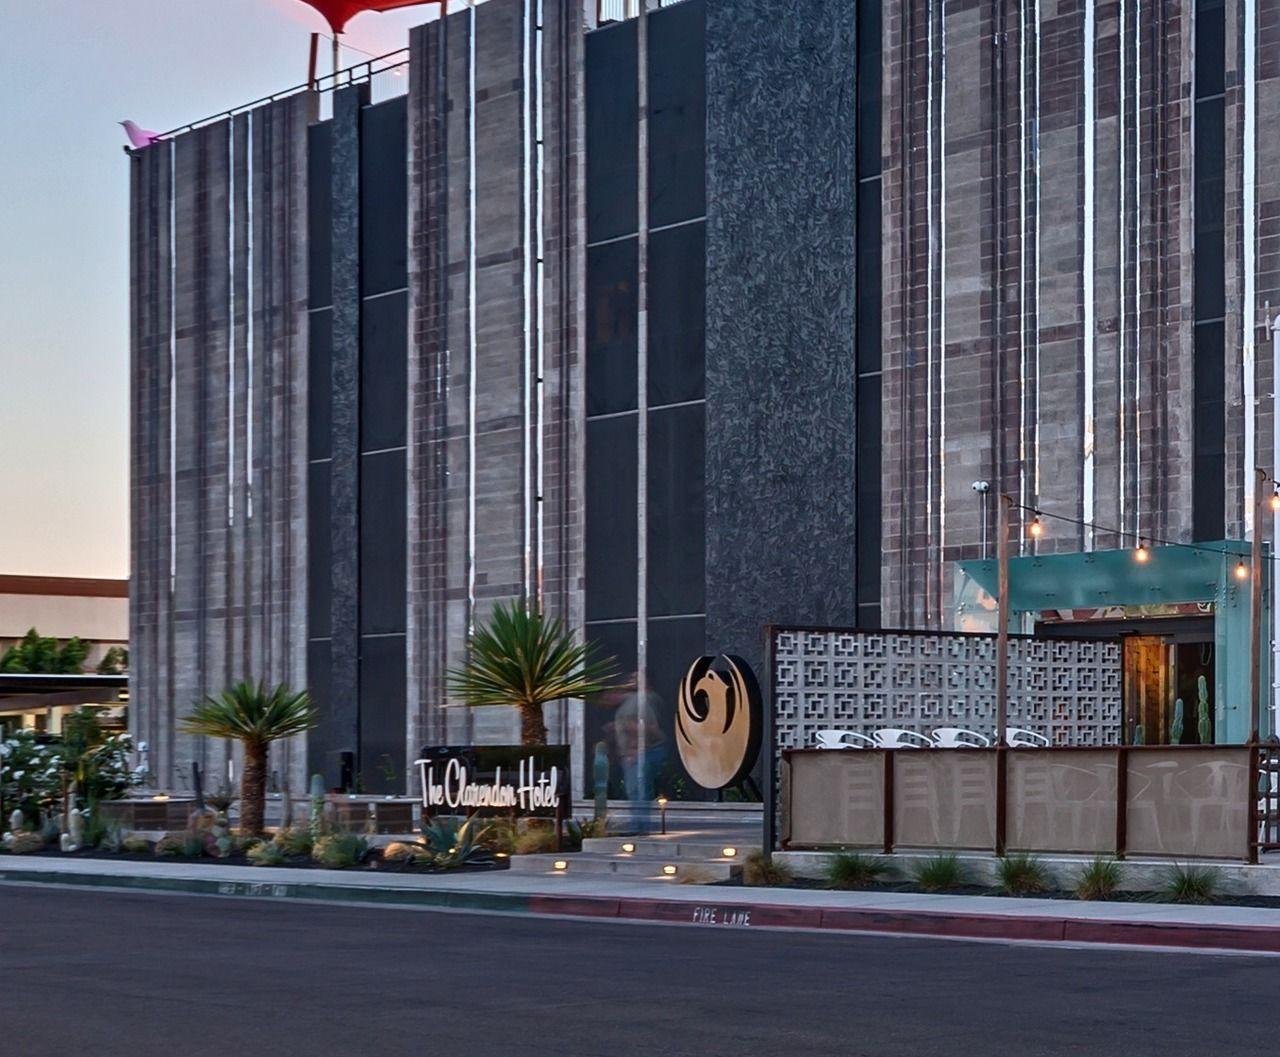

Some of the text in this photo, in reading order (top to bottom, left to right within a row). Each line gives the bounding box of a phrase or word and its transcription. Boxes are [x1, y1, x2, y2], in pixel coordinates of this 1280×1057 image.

[414, 756, 559, 811] The Clarendon Hotel
[692, 907, 752, 926] FIRE LANE
